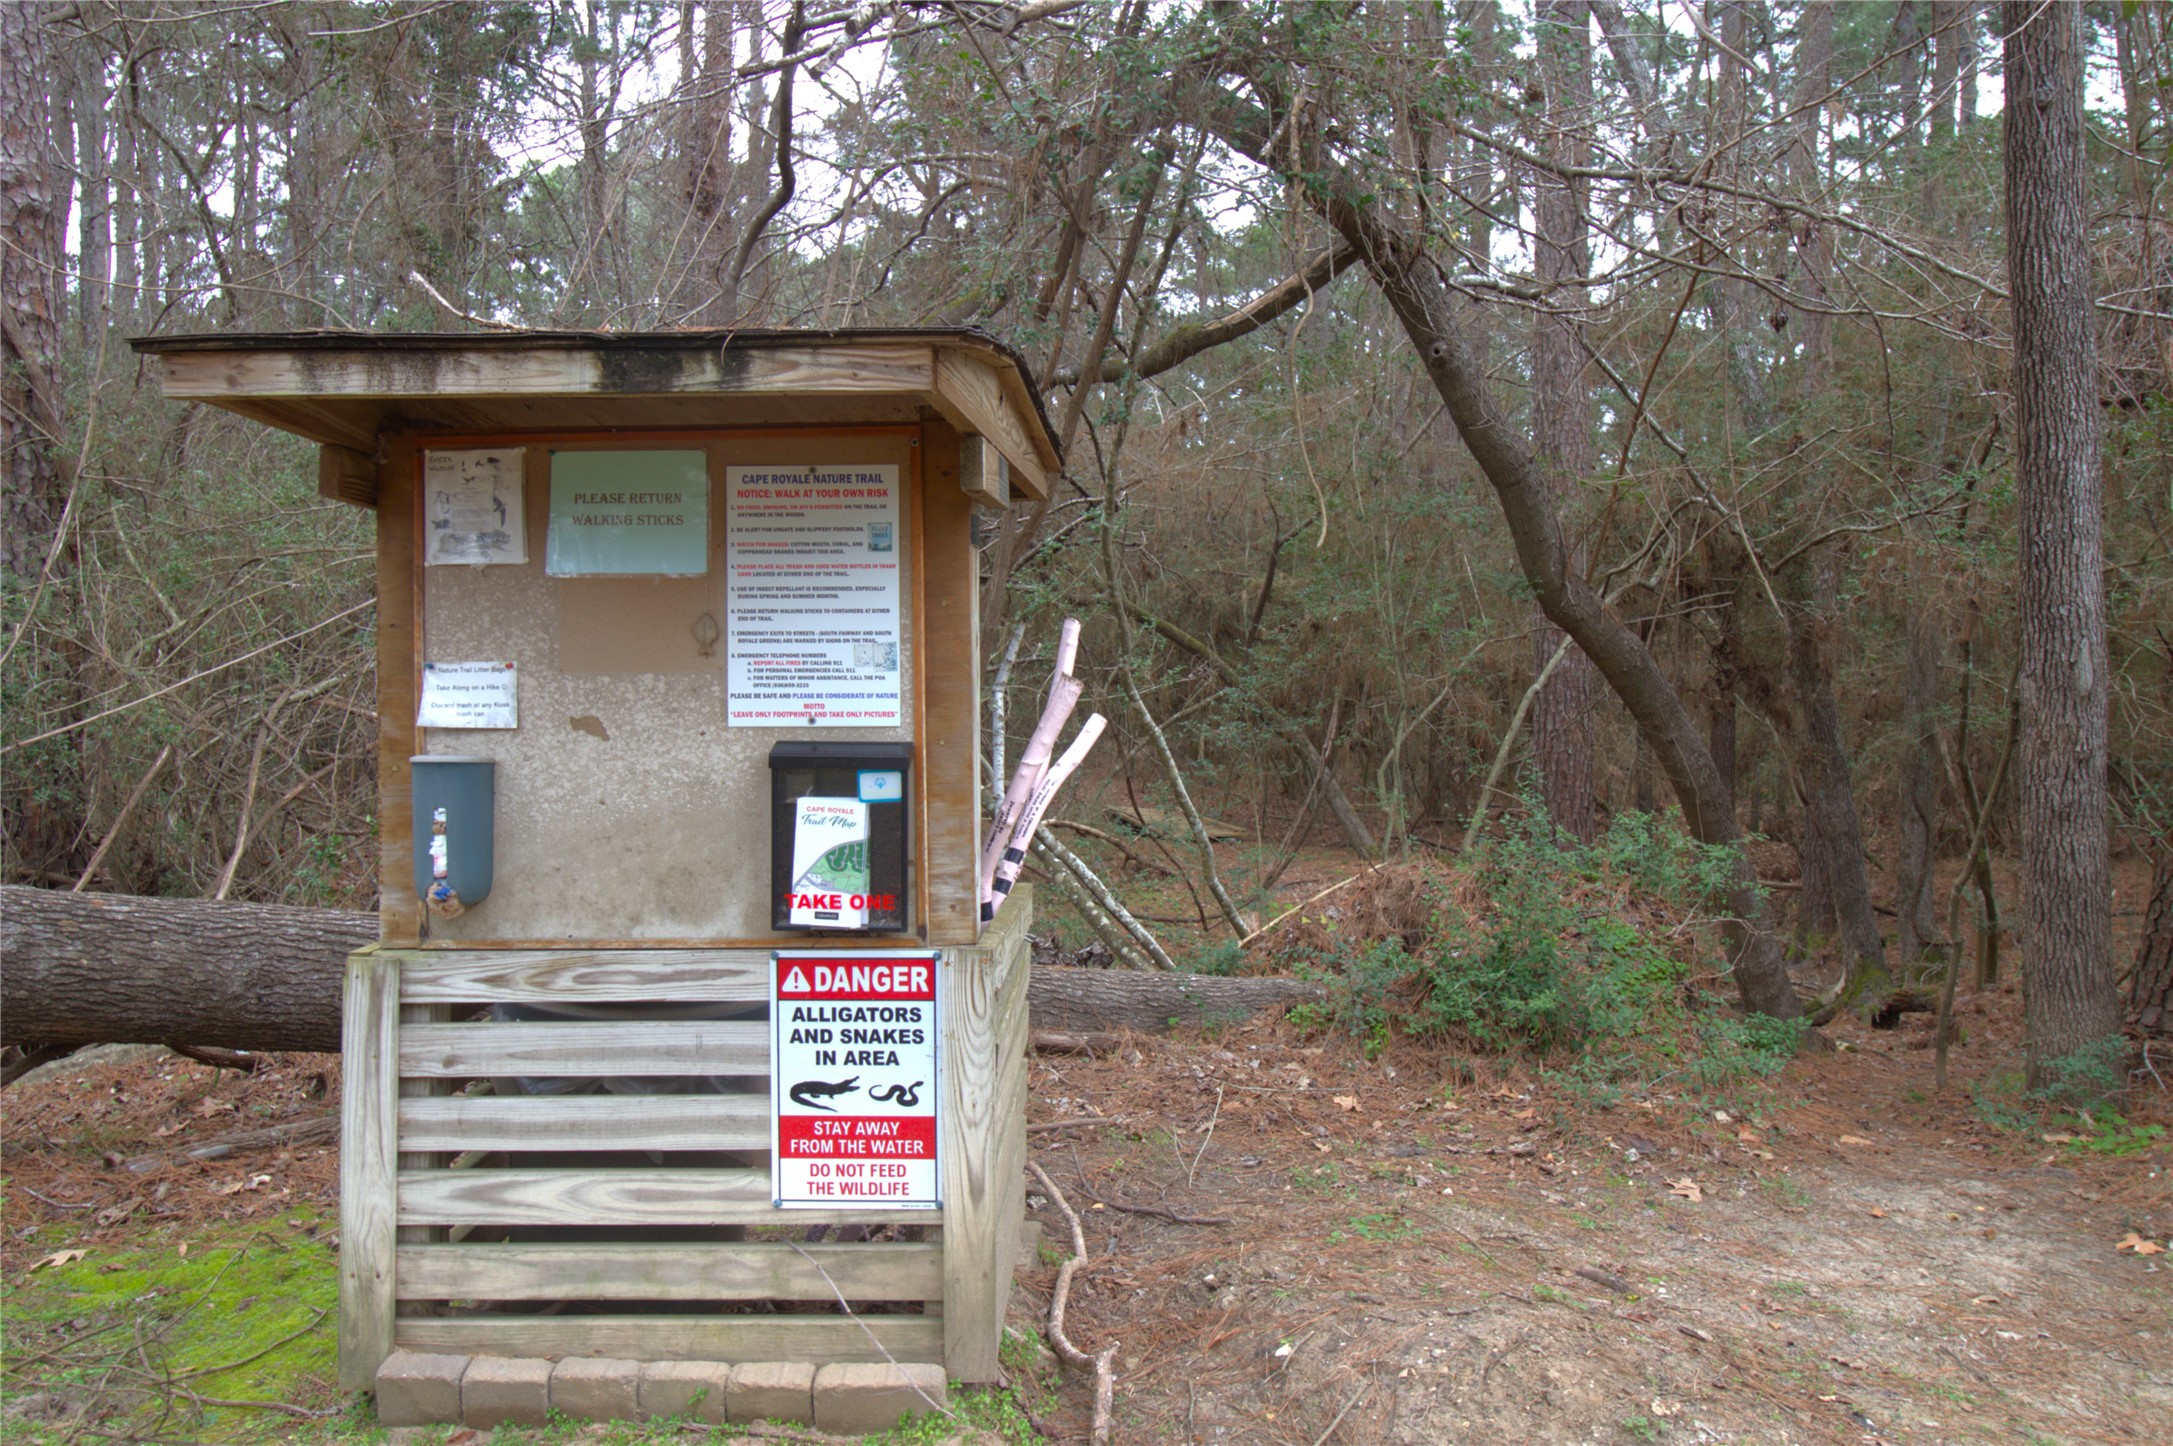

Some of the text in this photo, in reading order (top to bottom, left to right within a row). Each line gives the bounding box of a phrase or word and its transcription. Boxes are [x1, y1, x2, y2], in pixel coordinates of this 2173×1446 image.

[742, 473, 883, 485] CAPE ROYALE NATURE TRAIL
[574, 492, 682, 505] PLEASE RETURN
[737, 488, 888, 499] NOTICE: WALK AT YOUR OWN RISK
[572, 514, 685, 526] WALKING STICKS
[827, 807, 855, 815] ROYALE
[801, 813, 858, 829] Trail Map
[784, 894, 896, 911] TAKE ONE
[814, 965, 929, 993] DANGER
[791, 1007, 922, 1023] ALLIGATORS
[790, 1028, 925, 1045] AND SNAKES
[815, 1050, 900, 1066] IN AREA
[814, 1121, 900, 1135] STAY AWAY
[790, 1139, 924, 1154] FROM THE WATER
[810, 1163, 907, 1177] DO NOT FEED
[807, 1182, 910, 1196] THE WILDLIFE
